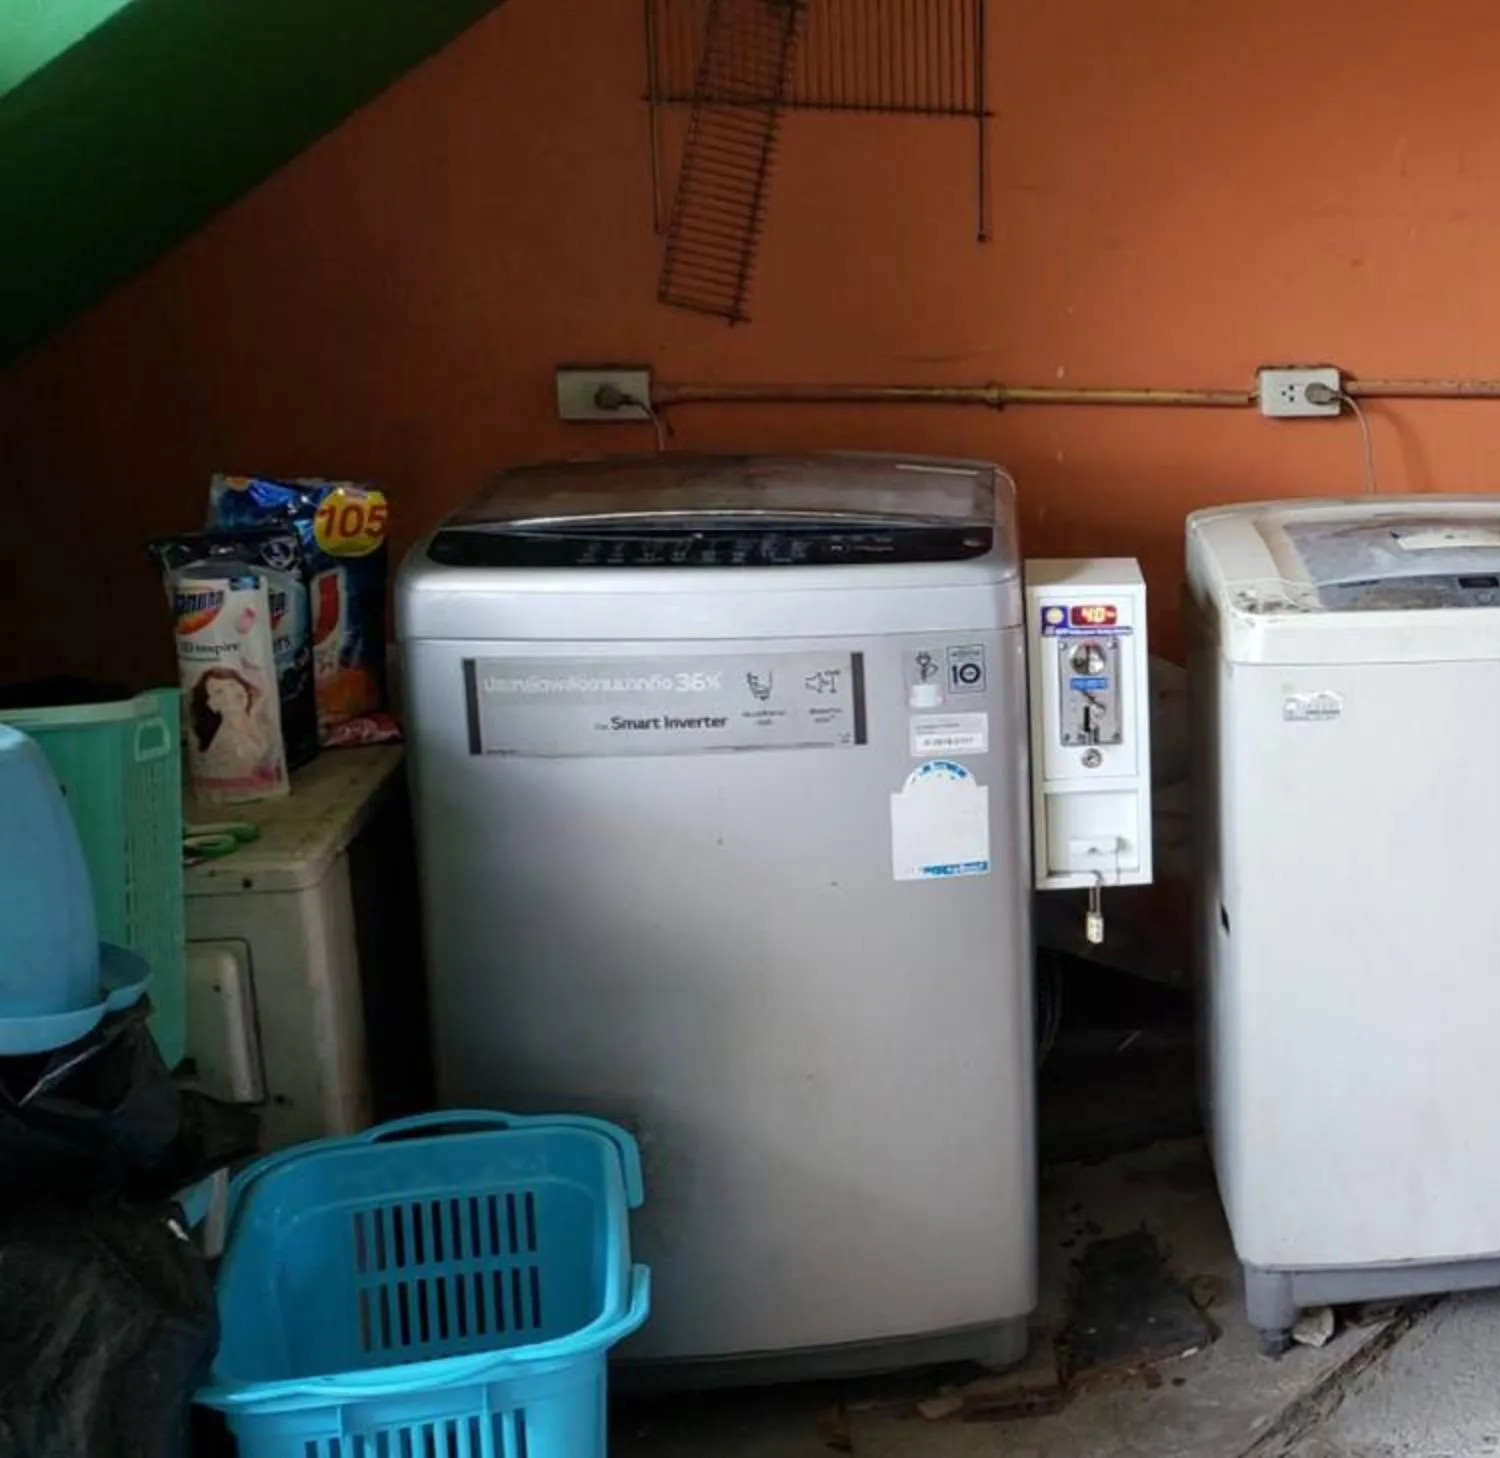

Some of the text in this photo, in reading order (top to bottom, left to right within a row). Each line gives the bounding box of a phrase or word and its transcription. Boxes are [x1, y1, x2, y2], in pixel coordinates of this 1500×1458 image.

[317, 503, 389, 539] 105
[610, 714, 660, 731] Smart
[663, 713, 729, 730] Inverter
